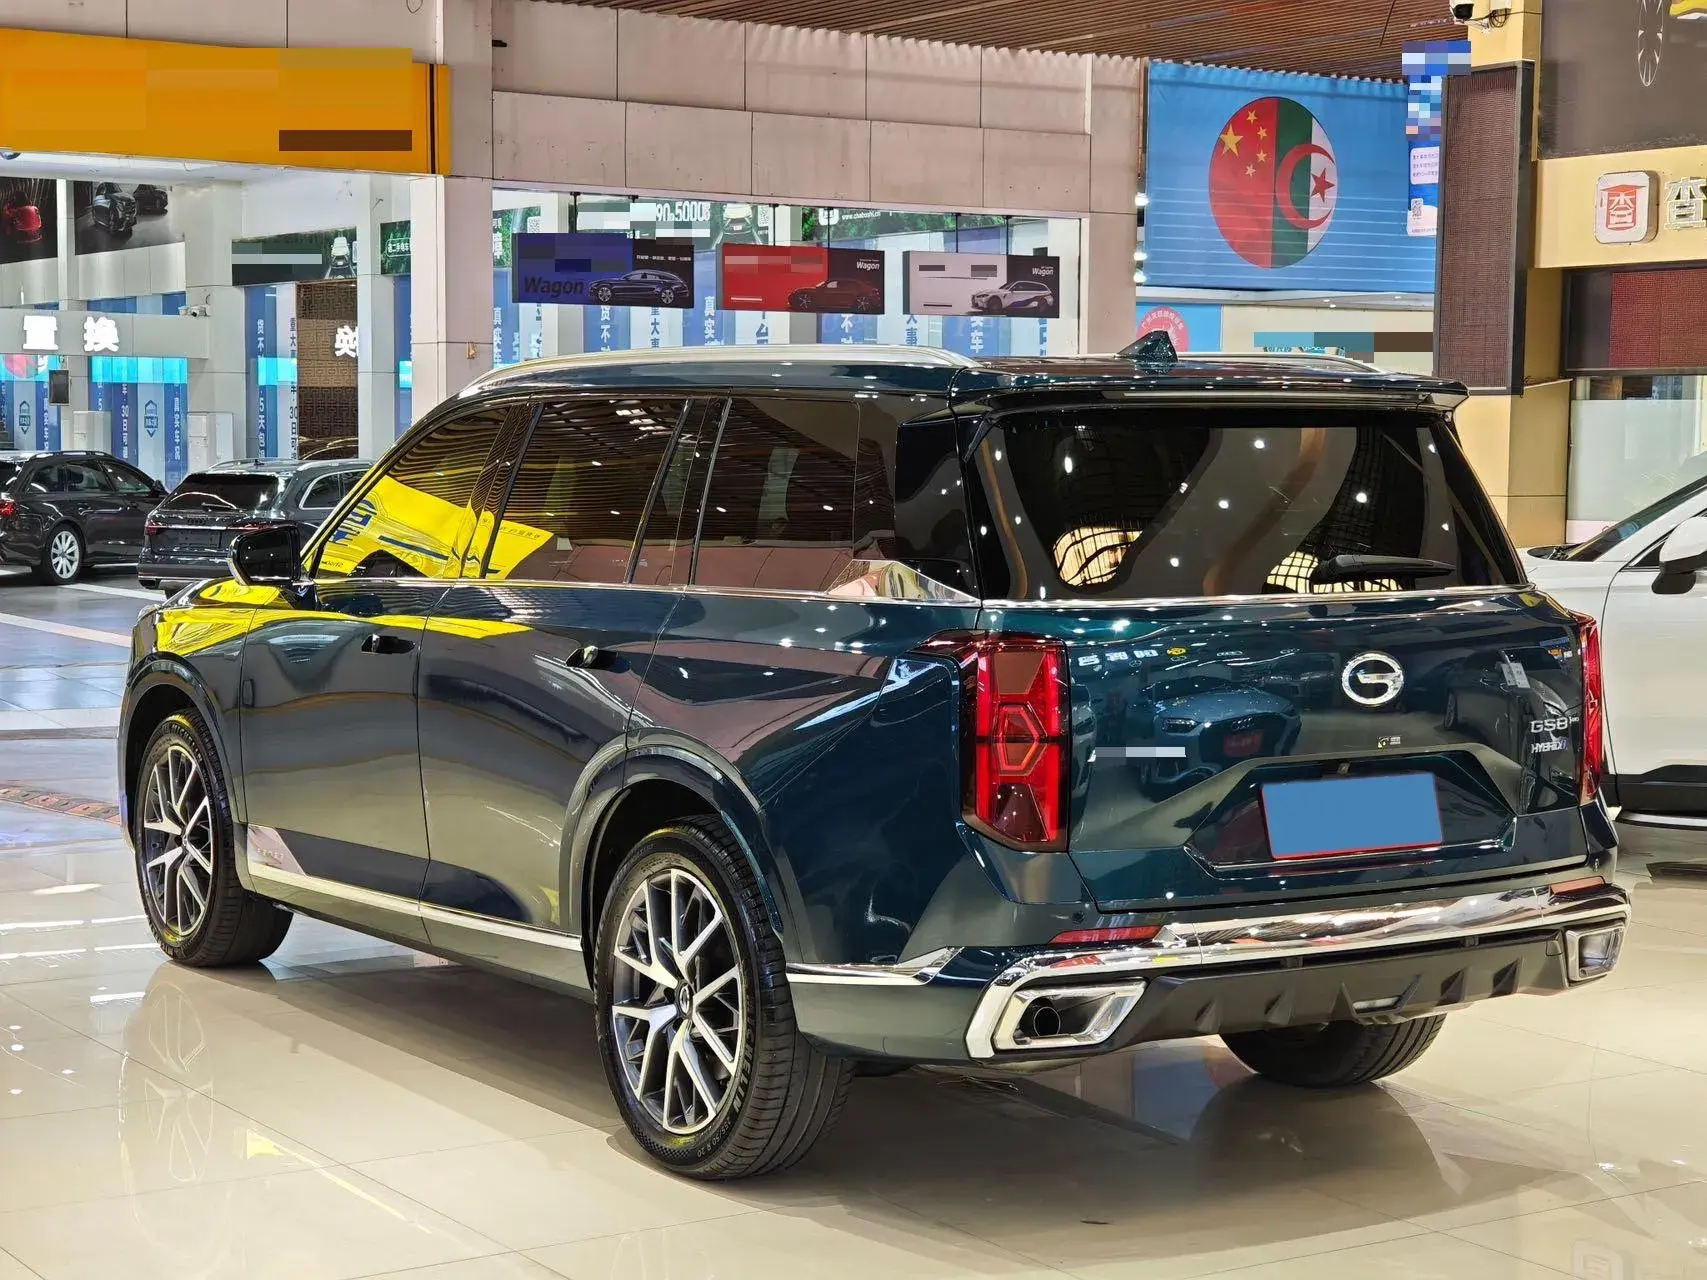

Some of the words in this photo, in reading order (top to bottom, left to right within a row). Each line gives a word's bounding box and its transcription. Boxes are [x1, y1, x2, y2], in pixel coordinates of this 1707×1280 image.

[856, 261, 880, 271] Wagon
[1032, 267, 1054, 276] Wagon
[524, 276, 584, 297] Wagon
[1530, 717, 1568, 733] GS8
[1531, 740, 1562, 754] HYBRID
